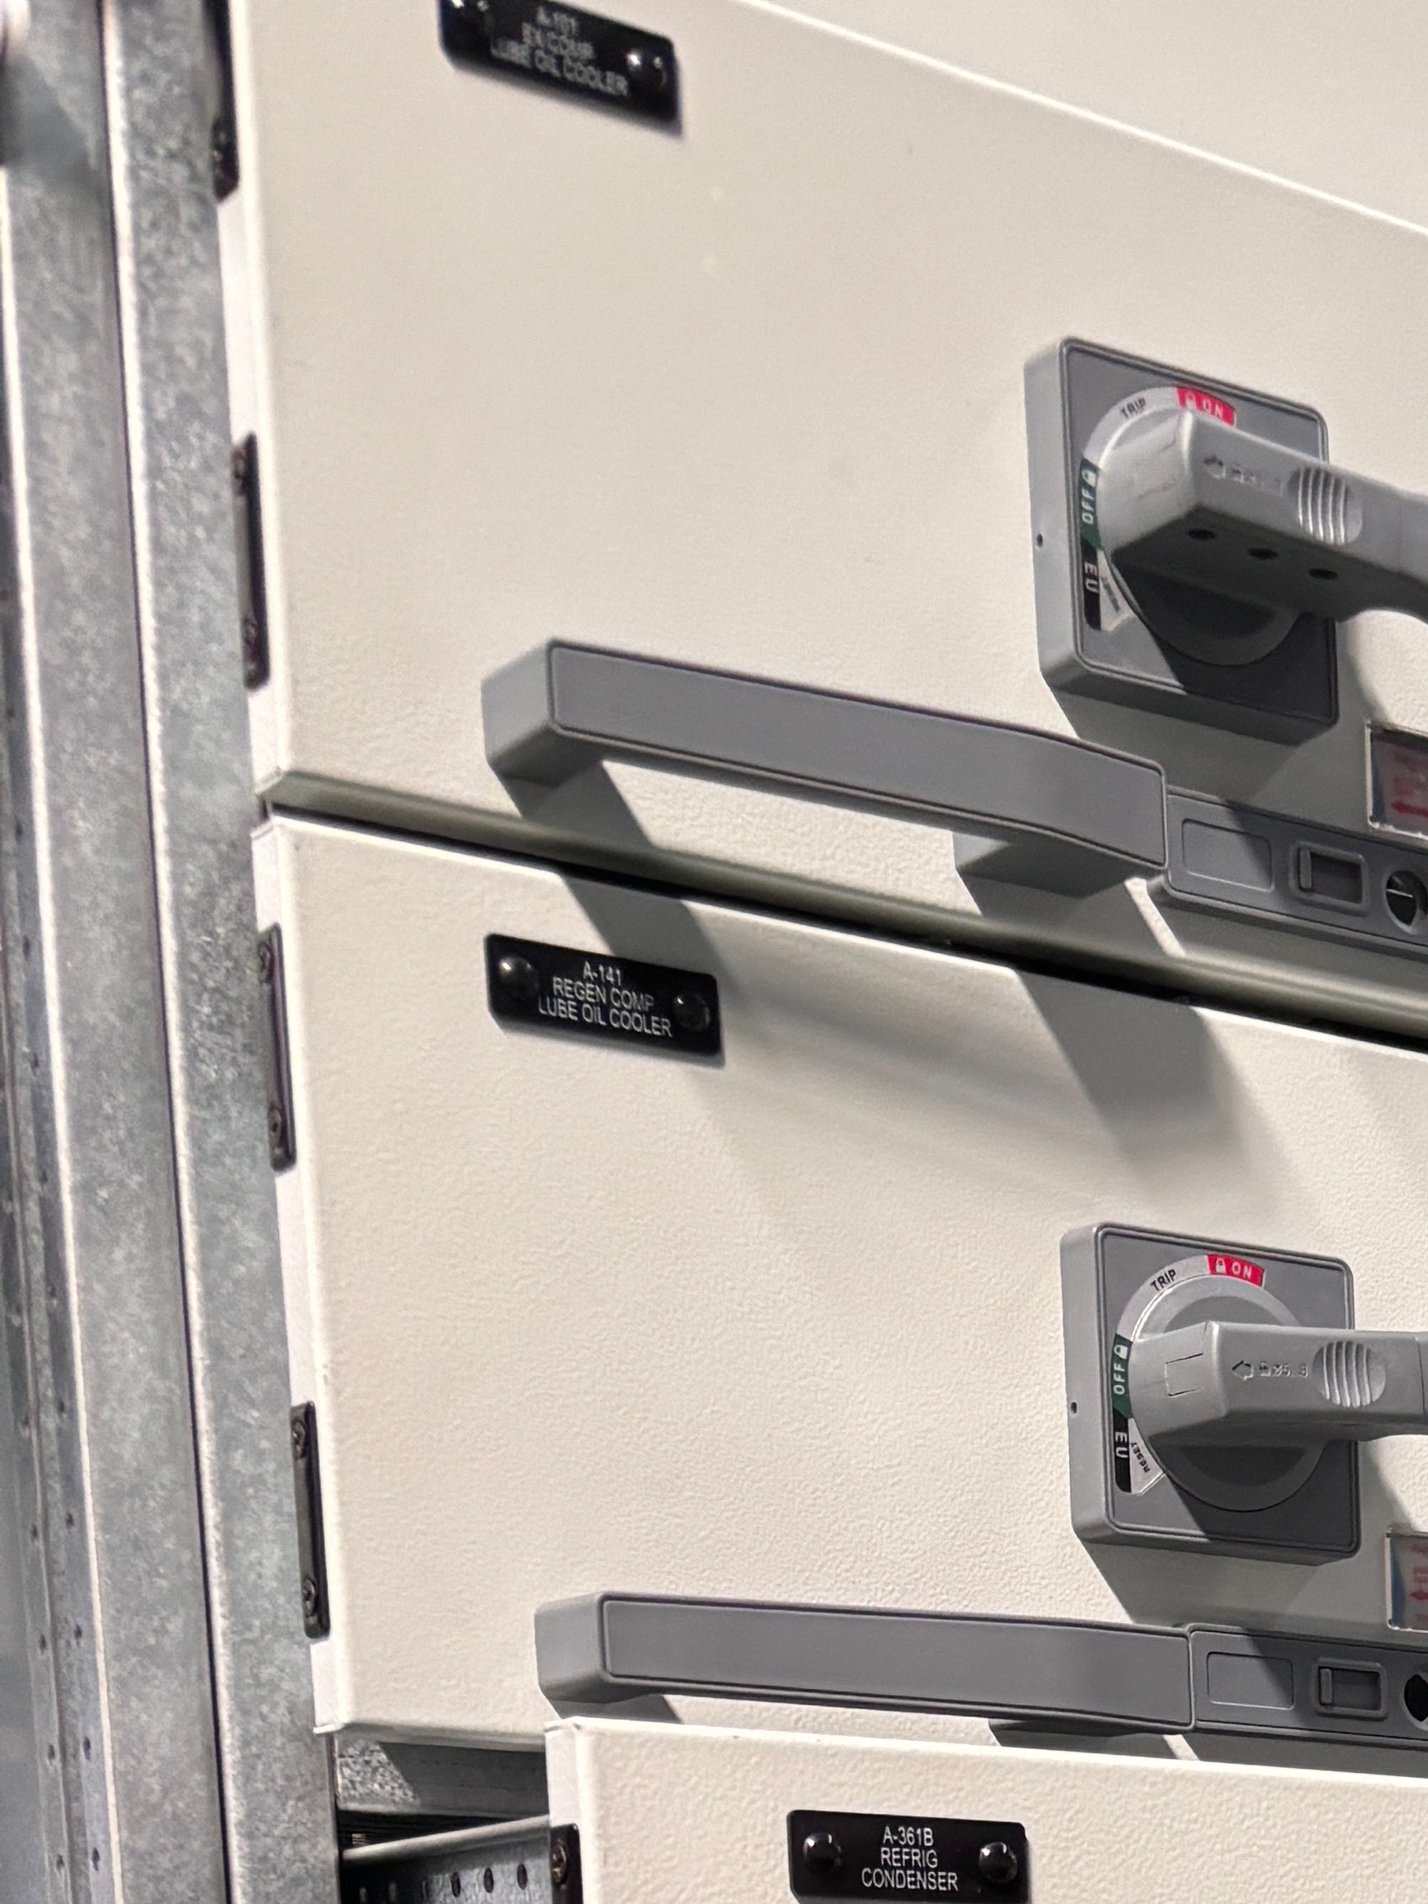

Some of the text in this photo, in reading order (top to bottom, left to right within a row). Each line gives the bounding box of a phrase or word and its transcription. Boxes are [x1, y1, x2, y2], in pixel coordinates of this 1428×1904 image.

[1121, 398, 1147, 420] TRIP
[1203, 400, 1224, 419] ON
[1081, 483, 1096, 526] OFF
[582, 960, 622, 986] A-141
[553, 977, 654, 1012] REGEN COMP
[538, 998, 672, 1037] LUBE OIL COOLER
[1150, 1268, 1178, 1293] TRIP
[1231, 1261, 1254, 1280] ON
[1113, 1362, 1126, 1396] OFF
[1130, 1441, 1151, 1473] RESET
[883, 1826, 934, 1846] A-361B
[881, 1848, 938, 1868] REFRIG
[861, 1868, 959, 1891] CONDENSER
